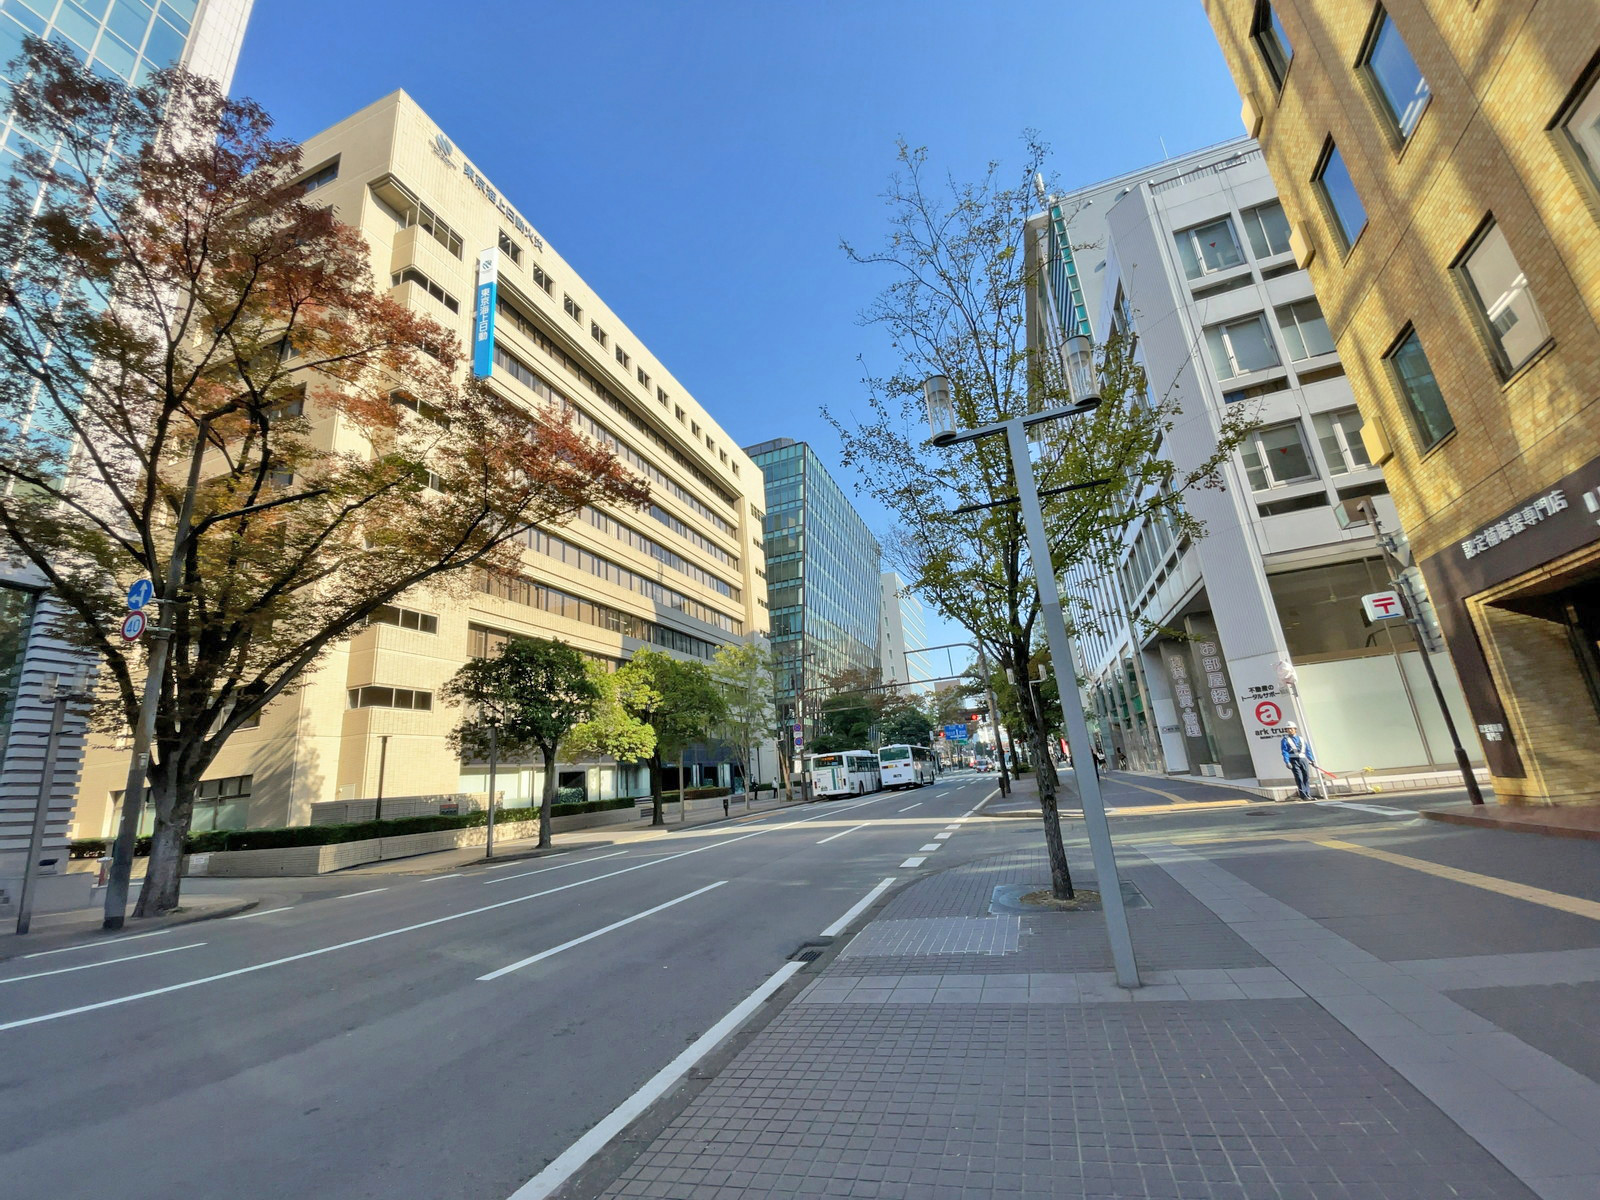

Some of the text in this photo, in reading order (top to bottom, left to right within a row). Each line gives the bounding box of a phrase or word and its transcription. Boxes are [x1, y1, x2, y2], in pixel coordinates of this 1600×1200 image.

[463, 162, 543, 253] 東京海上日動火災
[478, 288, 491, 341] 東京海上日動
[1461, 489, 1569, 560] 認定補聴器専門店
[126, 619, 140, 632] 40
[1200, 641, 1233, 720] お部屋探し
[1241, 690, 1284, 702] トータルサポー
[1248, 685, 1274, 693] 不動産の
[1255, 727, 1289, 736] ark trus
